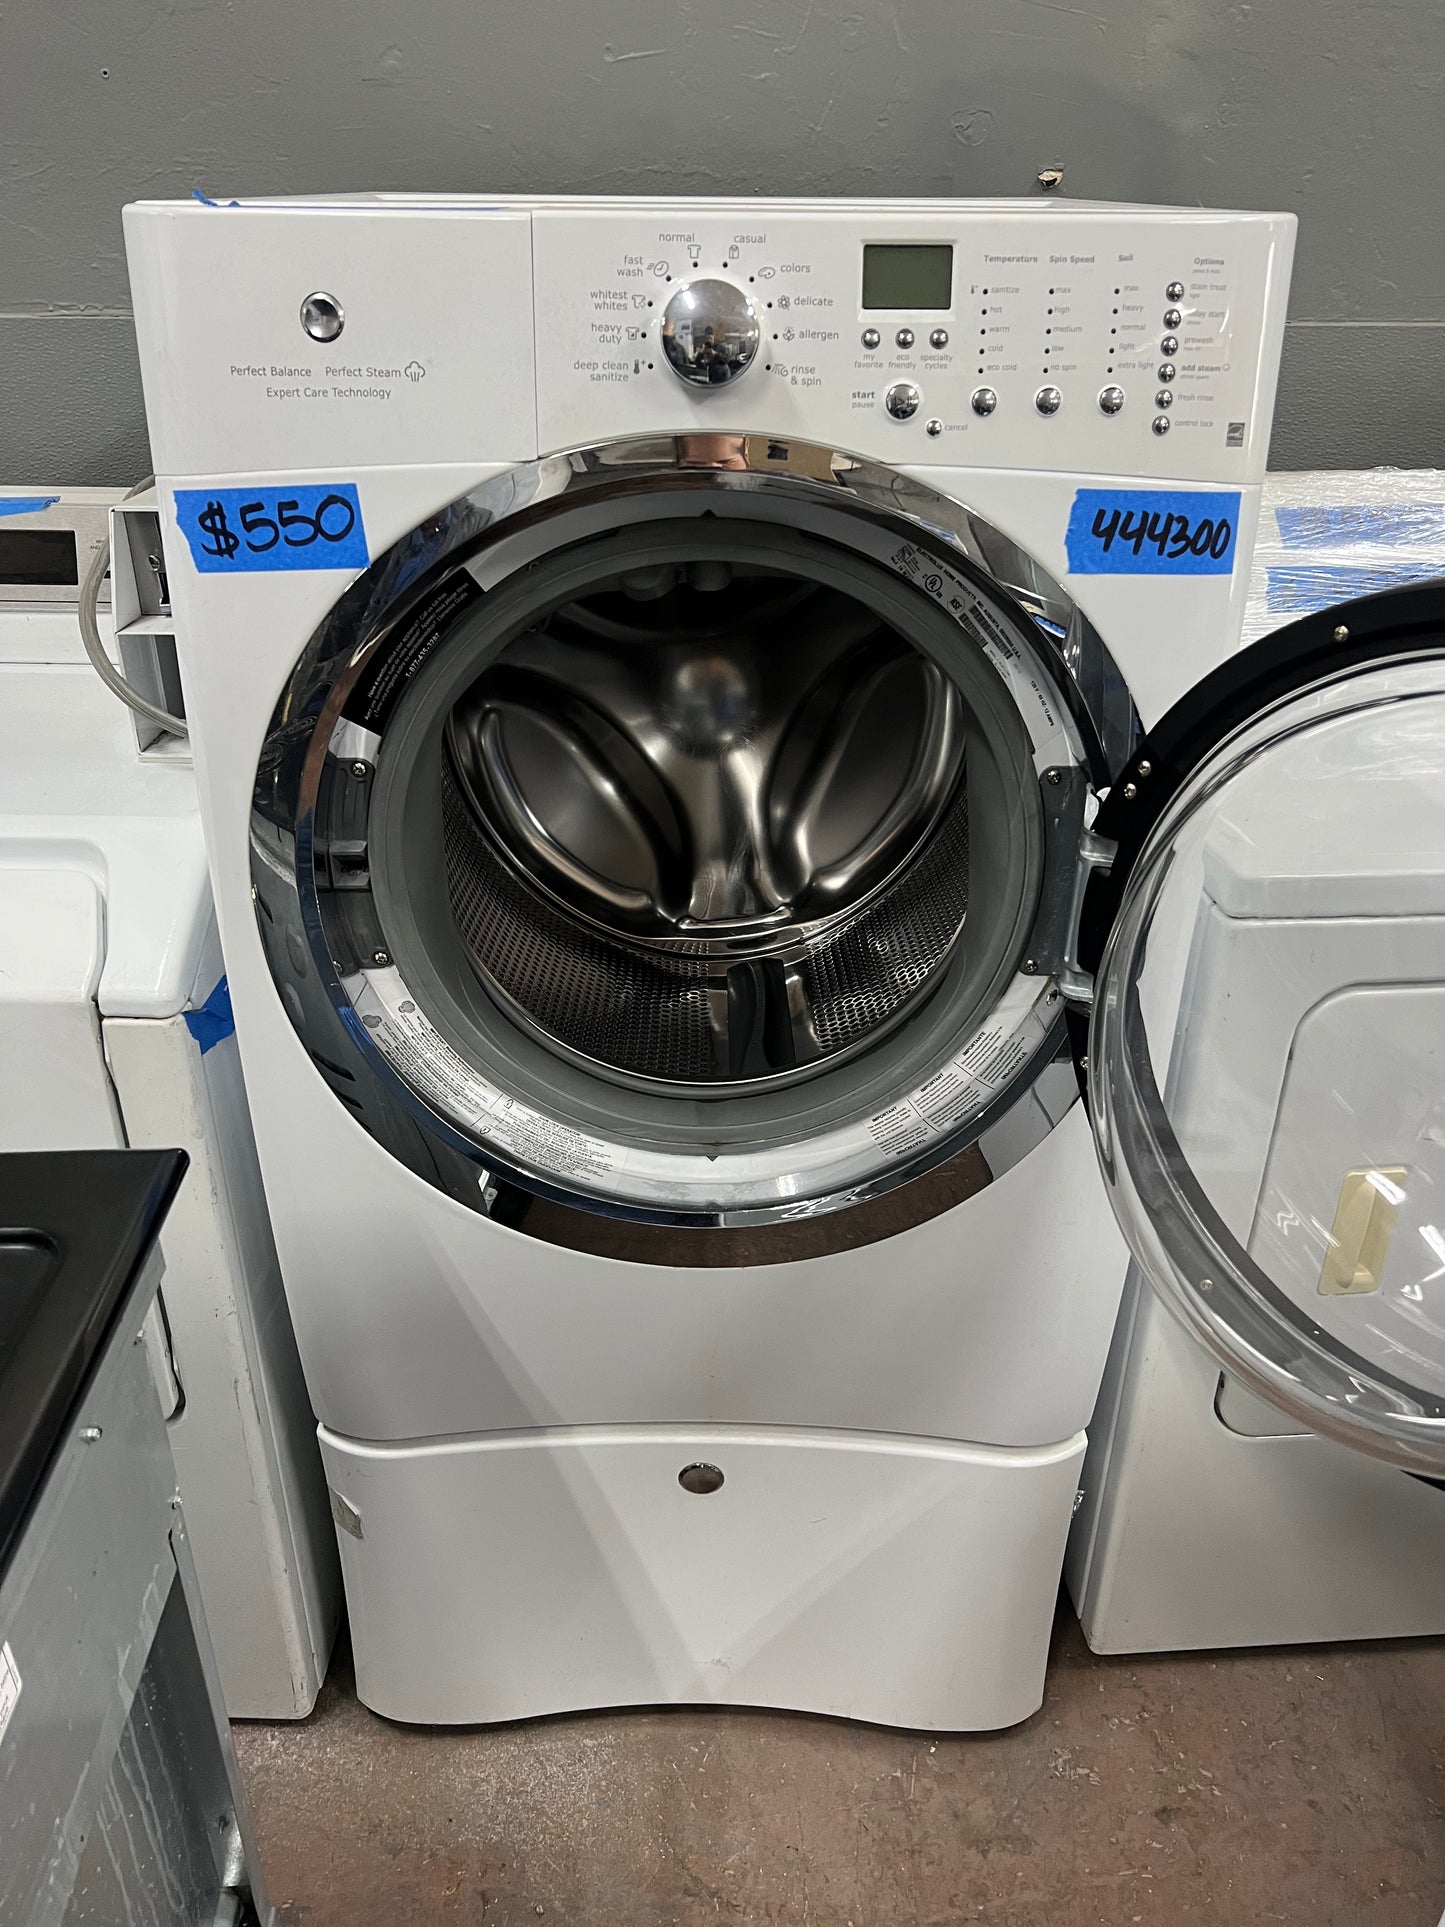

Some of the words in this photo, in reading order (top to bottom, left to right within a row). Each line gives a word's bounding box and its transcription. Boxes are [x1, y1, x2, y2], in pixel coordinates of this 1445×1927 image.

[658, 233, 695, 243] normal
[733, 234, 766, 243] casual
[624, 255, 643, 265] fast
[984, 255, 1038, 263] Temperature
[1119, 254, 1133, 262] Soil
[617, 267, 643, 277] wash
[780, 263, 811, 273] colors
[590, 290, 628, 300] whitest
[594, 301, 628, 311] whites
[794, 297, 834, 307] delicate
[1054, 306, 1070, 315] high
[1122, 304, 1144, 312] heavy
[591, 323, 622, 335] heavy
[599, 334, 622, 344] duty
[799, 330, 839, 341] allergen
[1119, 343, 1134, 351] light
[920, 354, 953, 362] specialty
[574, 361, 598, 372] deep
[601, 361, 628, 370] clean
[791, 364, 815, 374] rinse
[1062, 364, 1076, 372] spin
[1138, 362, 1153, 370] light
[230, 366, 266, 376] Perfect
[271, 367, 311, 377] Balance
[325, 367, 362, 377] Perfect
[366, 367, 401, 377] Steam
[590, 372, 628, 382] sanitize
[791, 377, 798, 385] &
[801, 377, 821, 387] spin
[267, 388, 300, 399] Expert
[304, 388, 328, 397] Care
[332, 388, 391, 399] Technology
[852, 391, 875, 399] start
[852, 401, 874, 409] pause
[197, 494, 356, 560] $550
[1091, 507, 1231, 560] 444300
